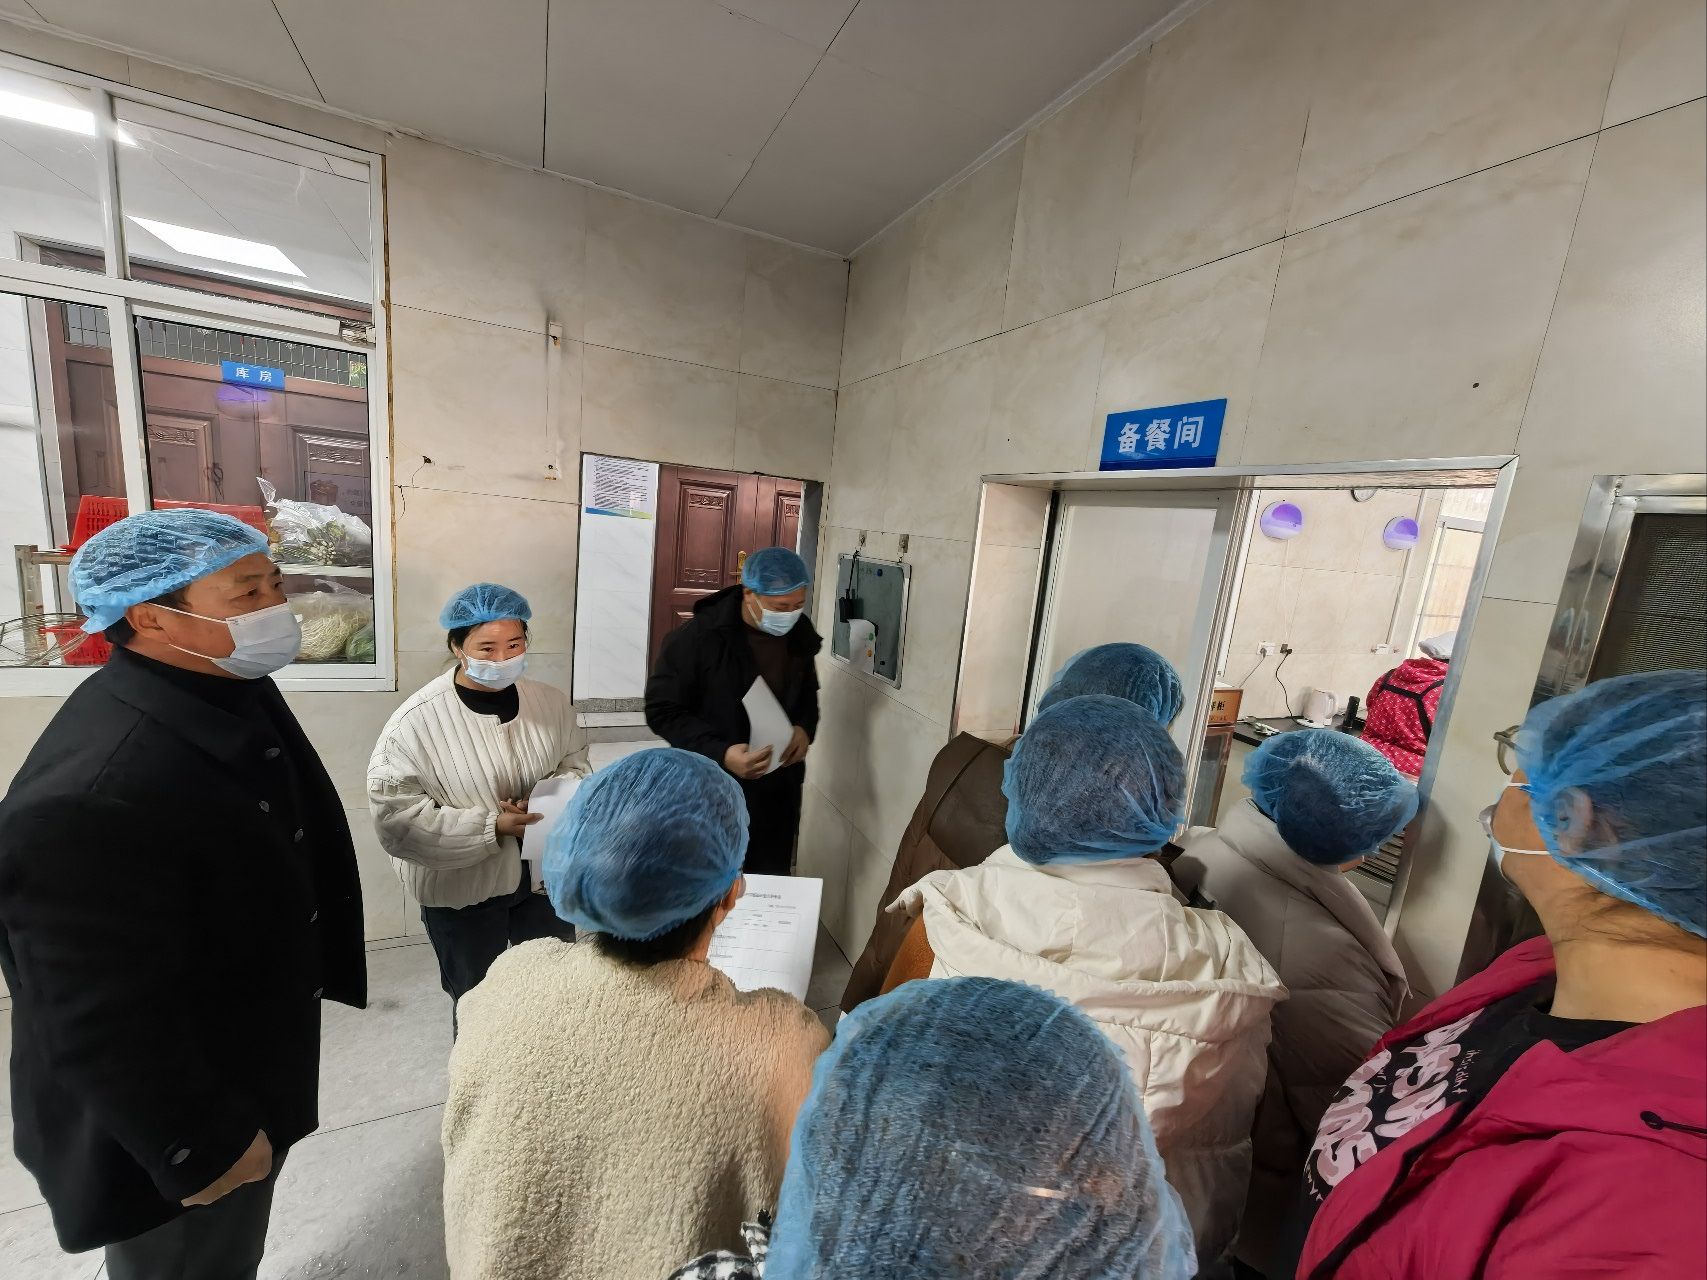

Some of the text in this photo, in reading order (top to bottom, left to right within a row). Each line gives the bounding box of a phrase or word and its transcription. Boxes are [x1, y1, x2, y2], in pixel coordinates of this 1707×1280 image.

[236, 367, 272, 383] 库房
[1118, 415, 1205, 453] 备餐间
